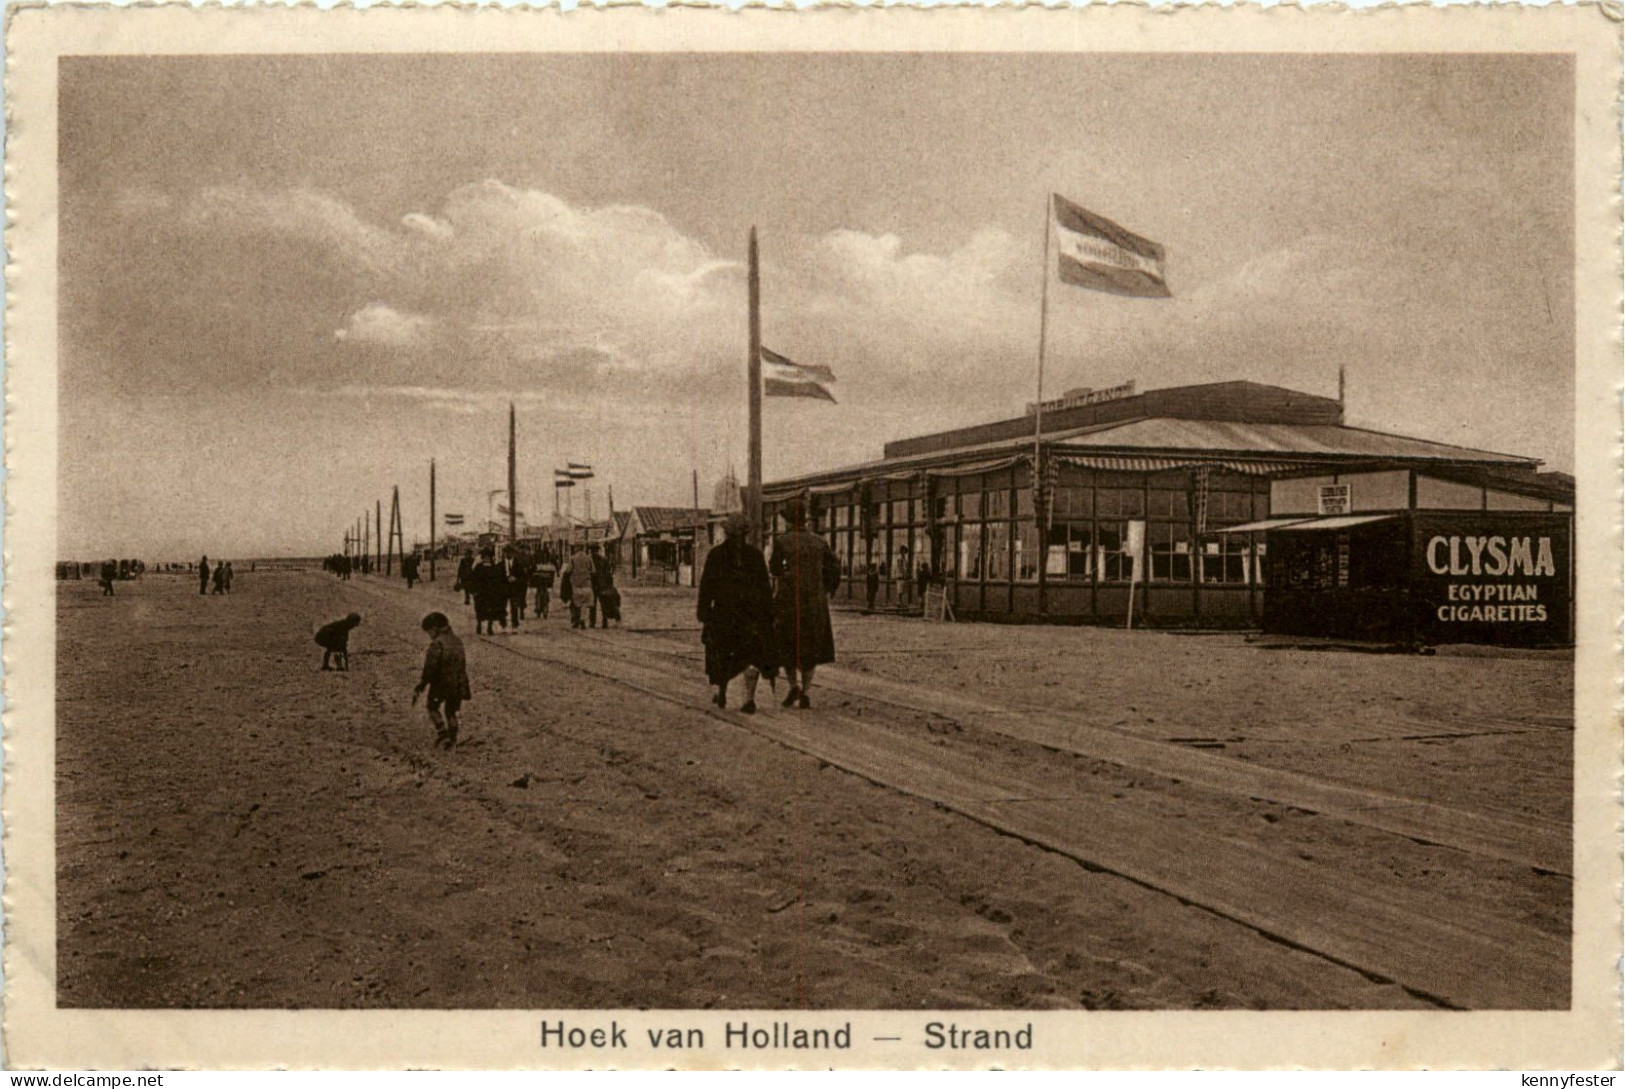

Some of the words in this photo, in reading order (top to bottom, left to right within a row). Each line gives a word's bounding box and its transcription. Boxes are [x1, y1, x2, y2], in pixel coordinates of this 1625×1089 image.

[1426, 535, 1556, 577] CLYSMA
[1448, 584, 1538, 601] EGYPTIAN
[1437, 604, 1548, 622] CIGARETTES
